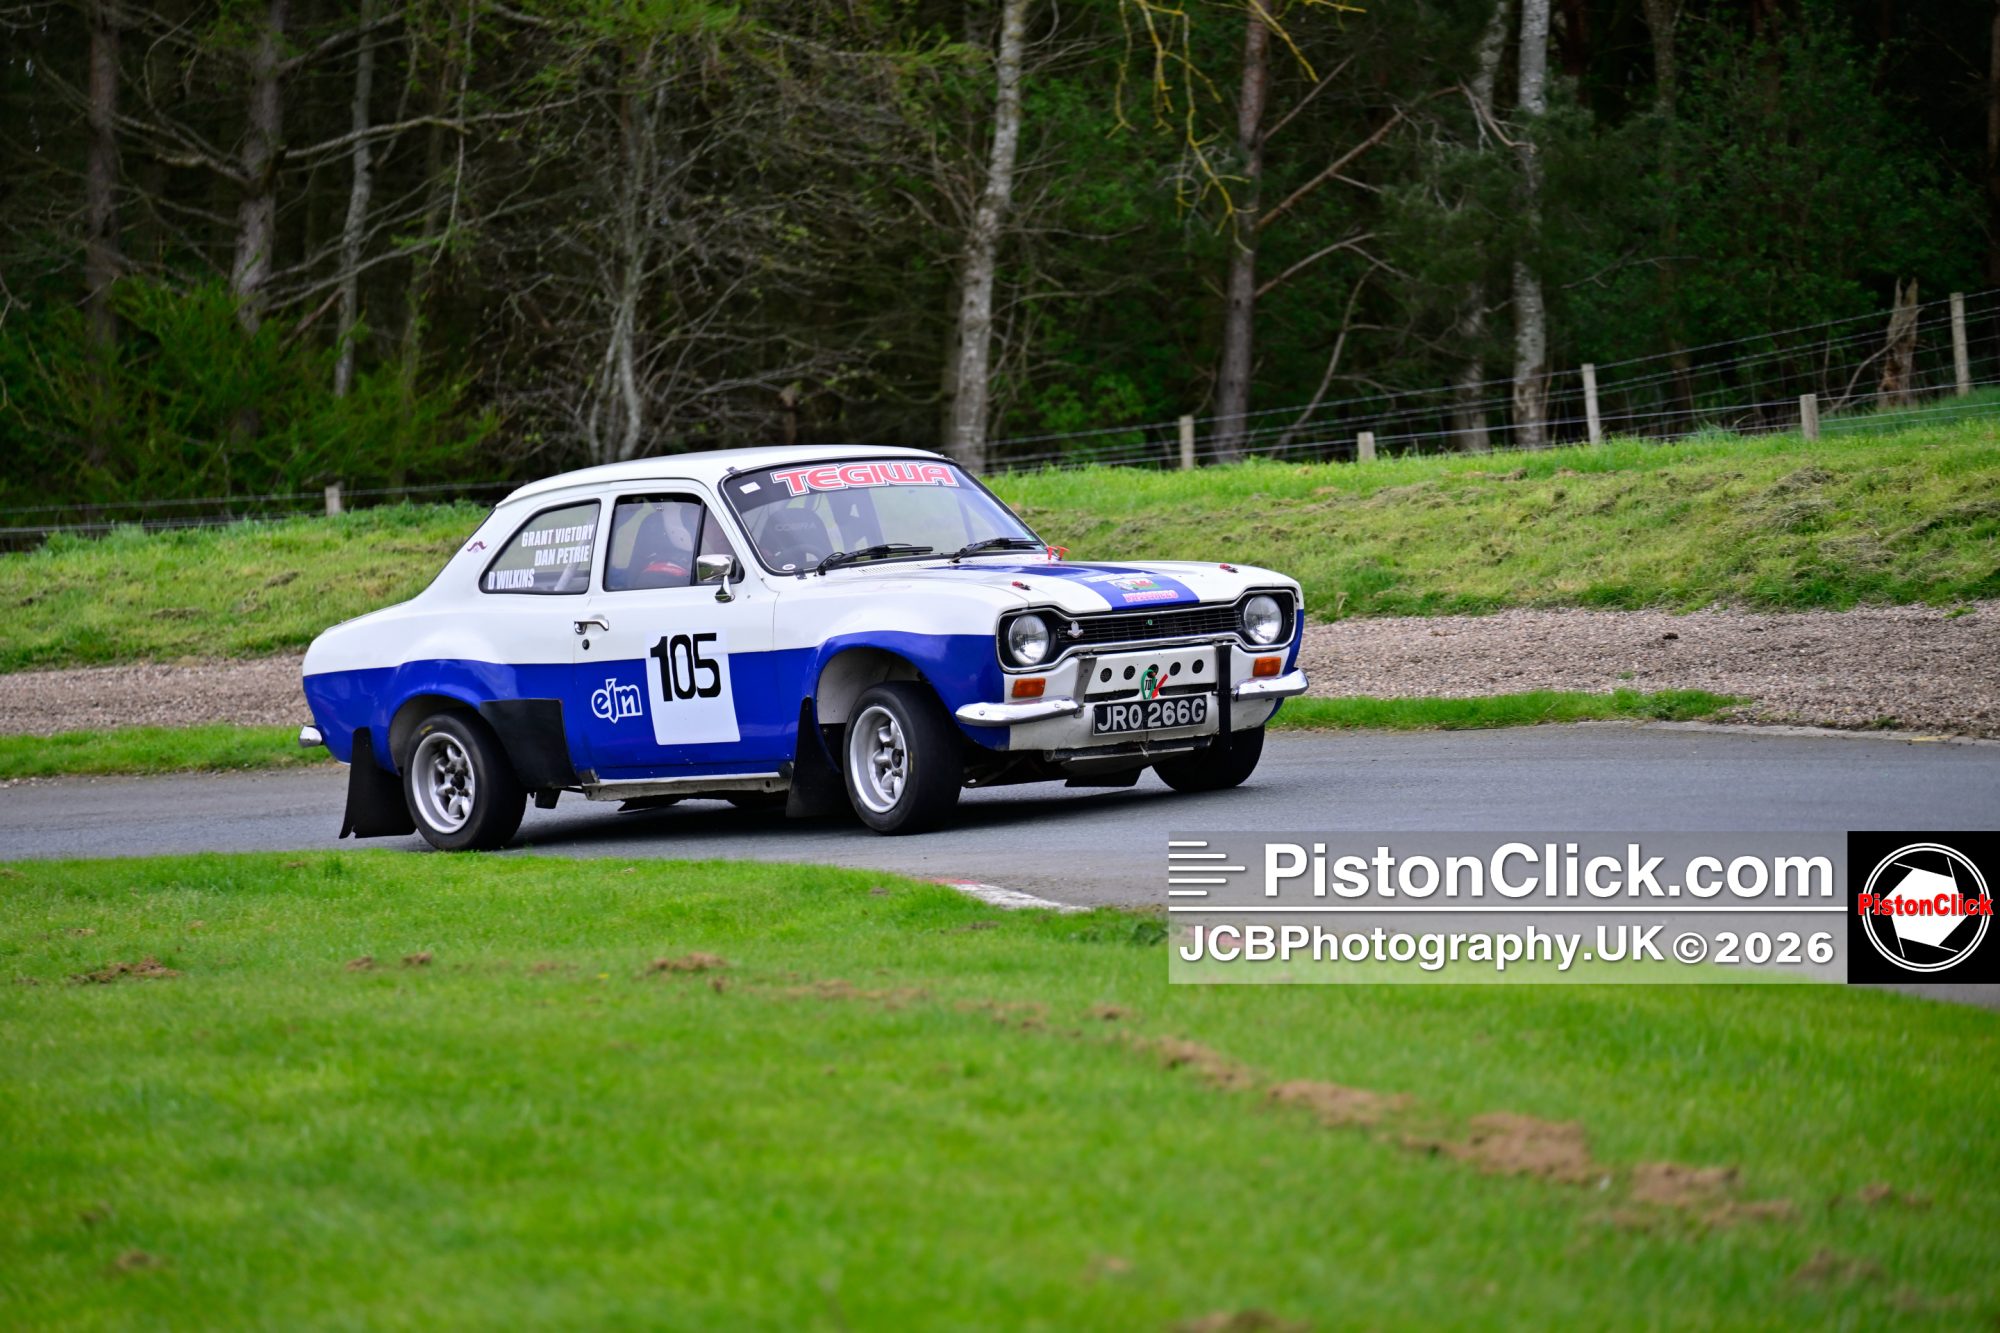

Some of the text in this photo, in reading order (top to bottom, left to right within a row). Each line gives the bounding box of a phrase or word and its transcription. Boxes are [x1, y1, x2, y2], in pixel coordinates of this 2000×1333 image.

[770, 462, 960, 496] TEGIWA
[521, 524, 594, 547] GRANT VICTORY
[534, 545, 590, 566] DAN PETRIE
[487, 568, 535, 590] D WILKINS
[650, 632, 722, 702] 105
[1097, 698, 1205, 731] JRO 266G
